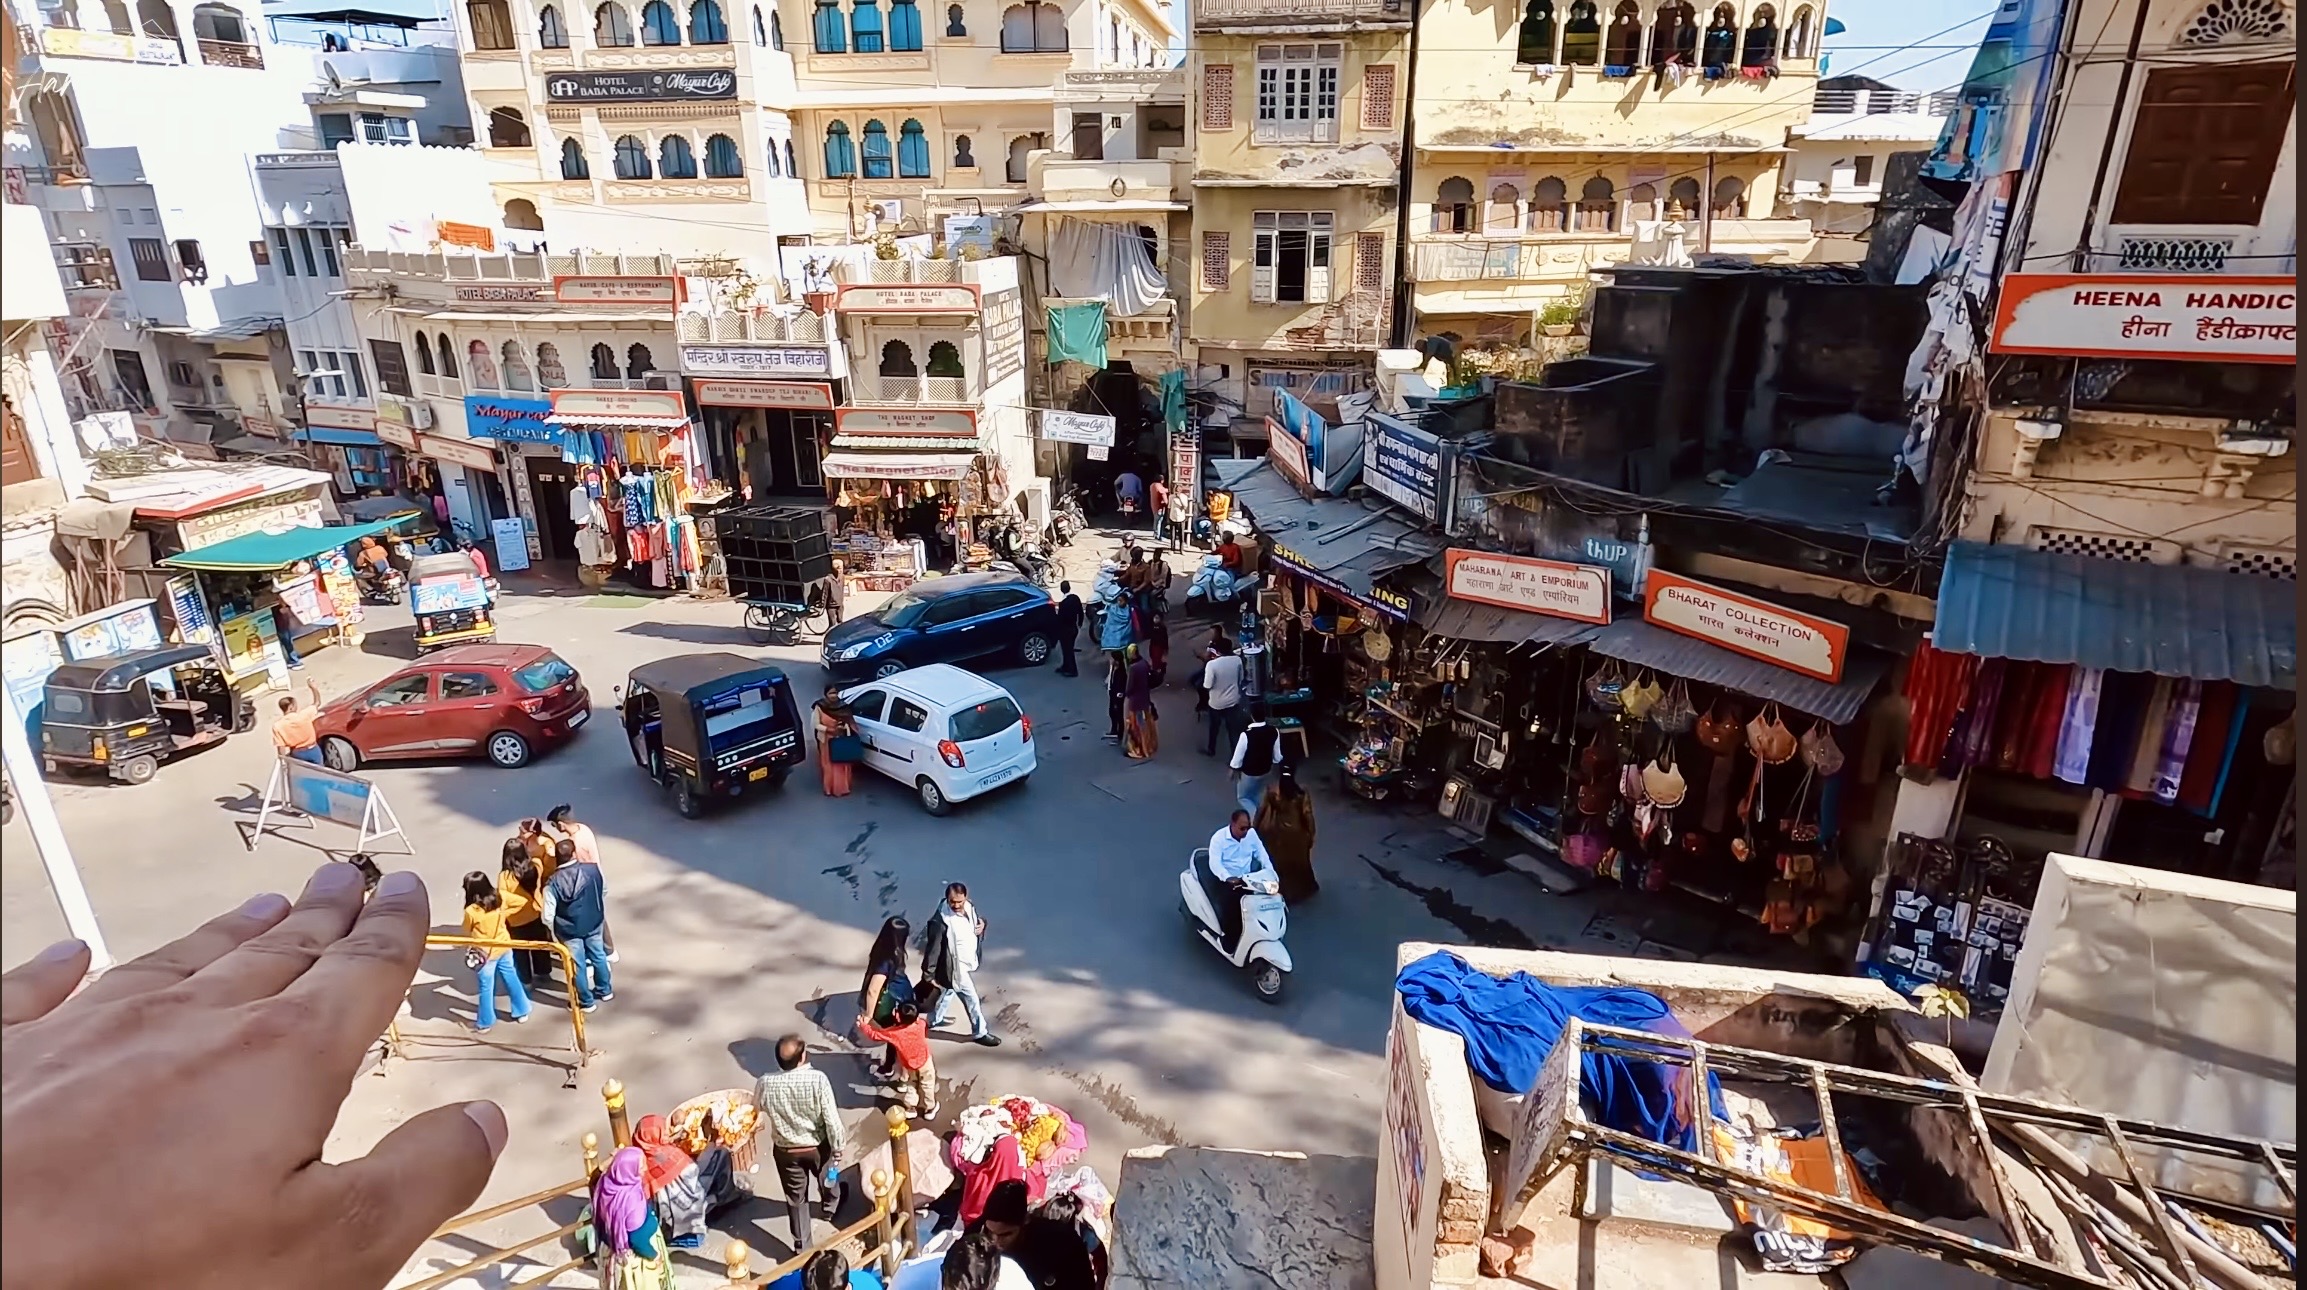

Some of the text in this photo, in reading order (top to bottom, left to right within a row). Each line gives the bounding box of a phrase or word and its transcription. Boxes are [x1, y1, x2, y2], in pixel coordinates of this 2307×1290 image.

[594, 76, 628, 86] HOTEL
[580, 86, 645, 97] BABA PALACE
[2073, 291, 2162, 307] HEENA
[2121, 315, 2173, 339] हीना
[864, 465, 920, 477] Magnet
[921, 465, 957, 478] Shop
[1459, 563, 1589, 591] MAHARANA ART & EMPORIUM
[1466, 578, 1494, 591] महाराणा
[1668, 588, 1812, 641] BHARAT COLLECTION
[1733, 625, 1780, 648] कलेक्शन
